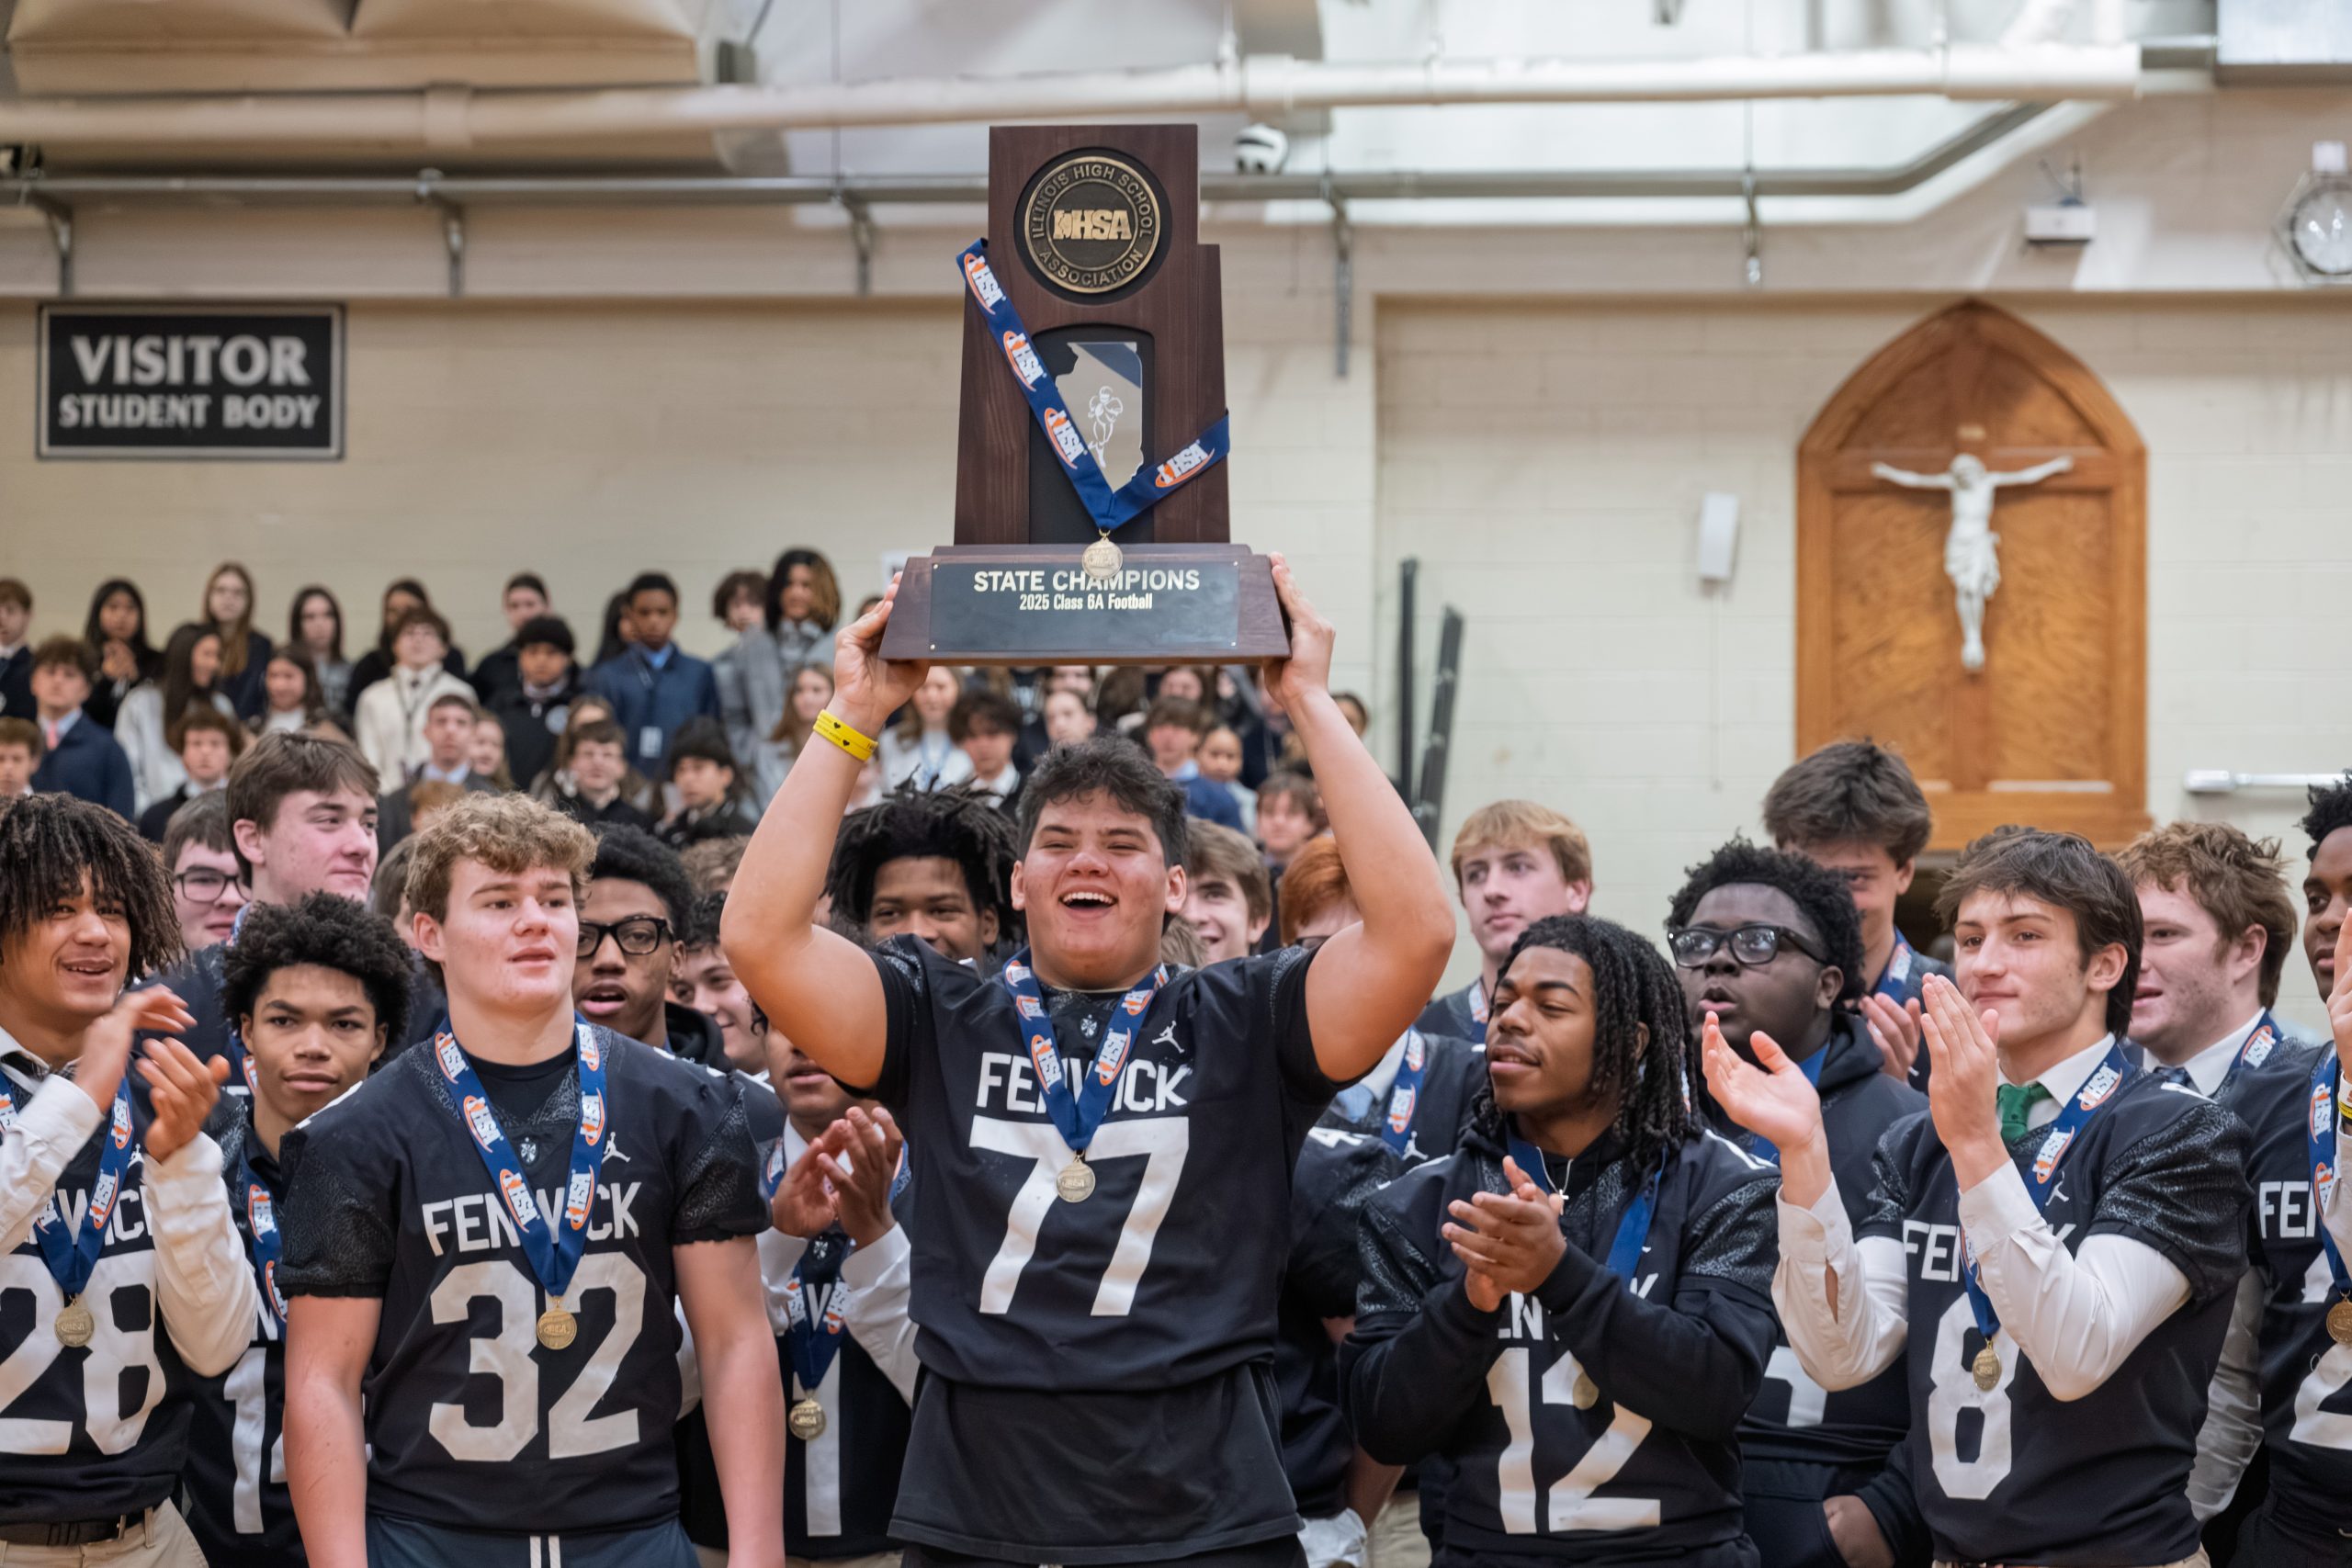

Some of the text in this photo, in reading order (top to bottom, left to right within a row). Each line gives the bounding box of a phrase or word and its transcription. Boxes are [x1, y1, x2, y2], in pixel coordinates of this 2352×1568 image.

[1033, 164, 1153, 239] ILLINOIS HIGH SCHOOL
[1039, 248, 1144, 287] ASSOCIATION
[71, 334, 311, 387] VISITOR
[59, 394, 322, 429] STUDENT BODY
[974, 569, 1201, 592] STATE CHAMPIONS
[1019, 592, 1153, 611] 2025 Class 6A Football
[422, 1182, 642, 1257] FENCK
[969, 1116, 1190, 1315] 77
[0, 1249, 166, 1455] 28
[429, 1252, 647, 1461] 32
[1928, 1292, 2022, 1499] 8
[223, 1347, 288, 1534] 1
[1487, 1348, 1661, 1534] 12
